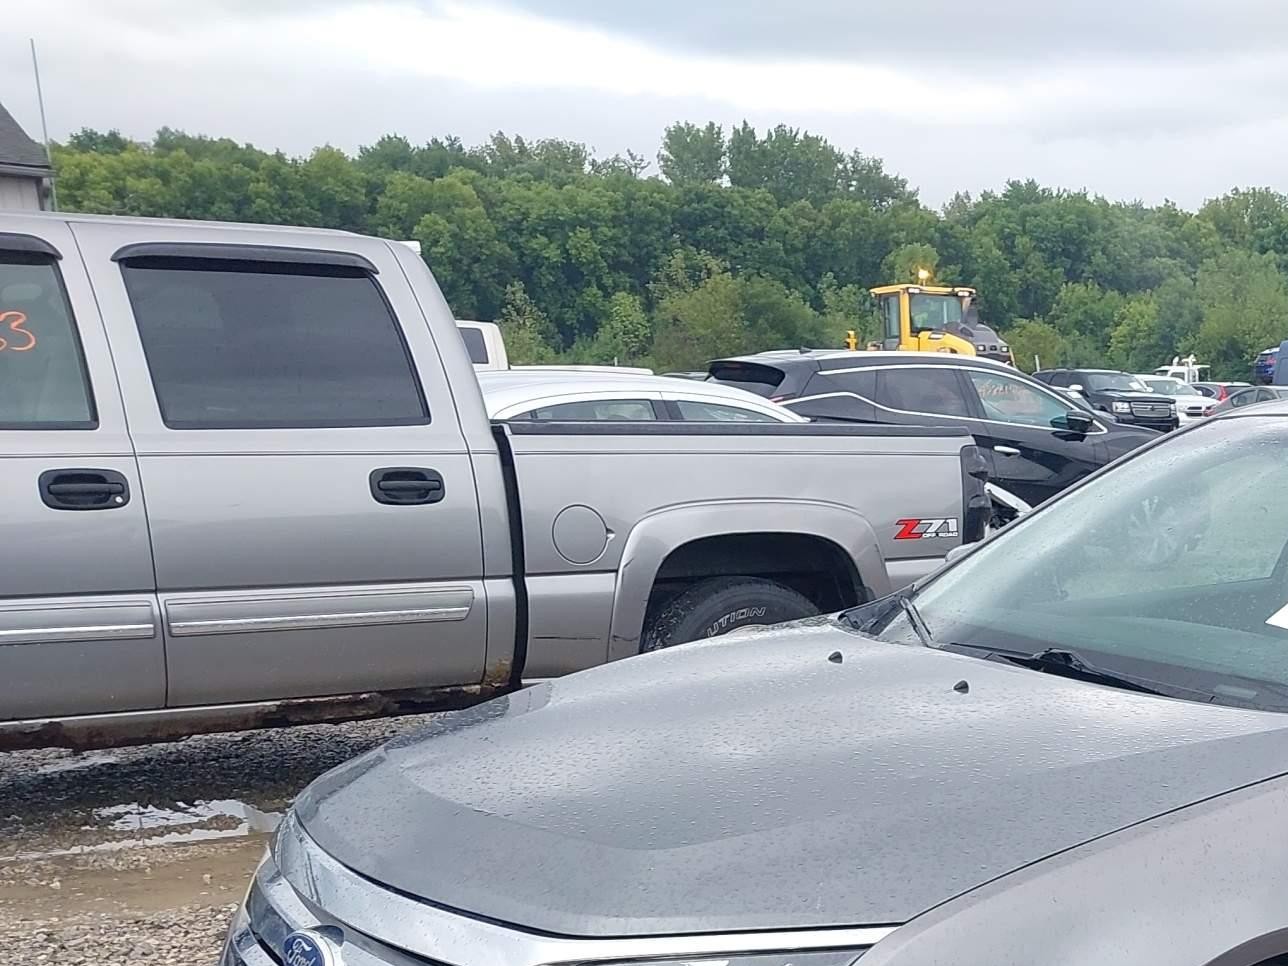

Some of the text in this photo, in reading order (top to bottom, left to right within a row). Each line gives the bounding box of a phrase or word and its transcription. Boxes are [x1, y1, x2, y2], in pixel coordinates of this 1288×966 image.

[0, 311, 37, 351] 3
[894, 518, 959, 540] Z71
[706, 607, 767, 637] UTION
